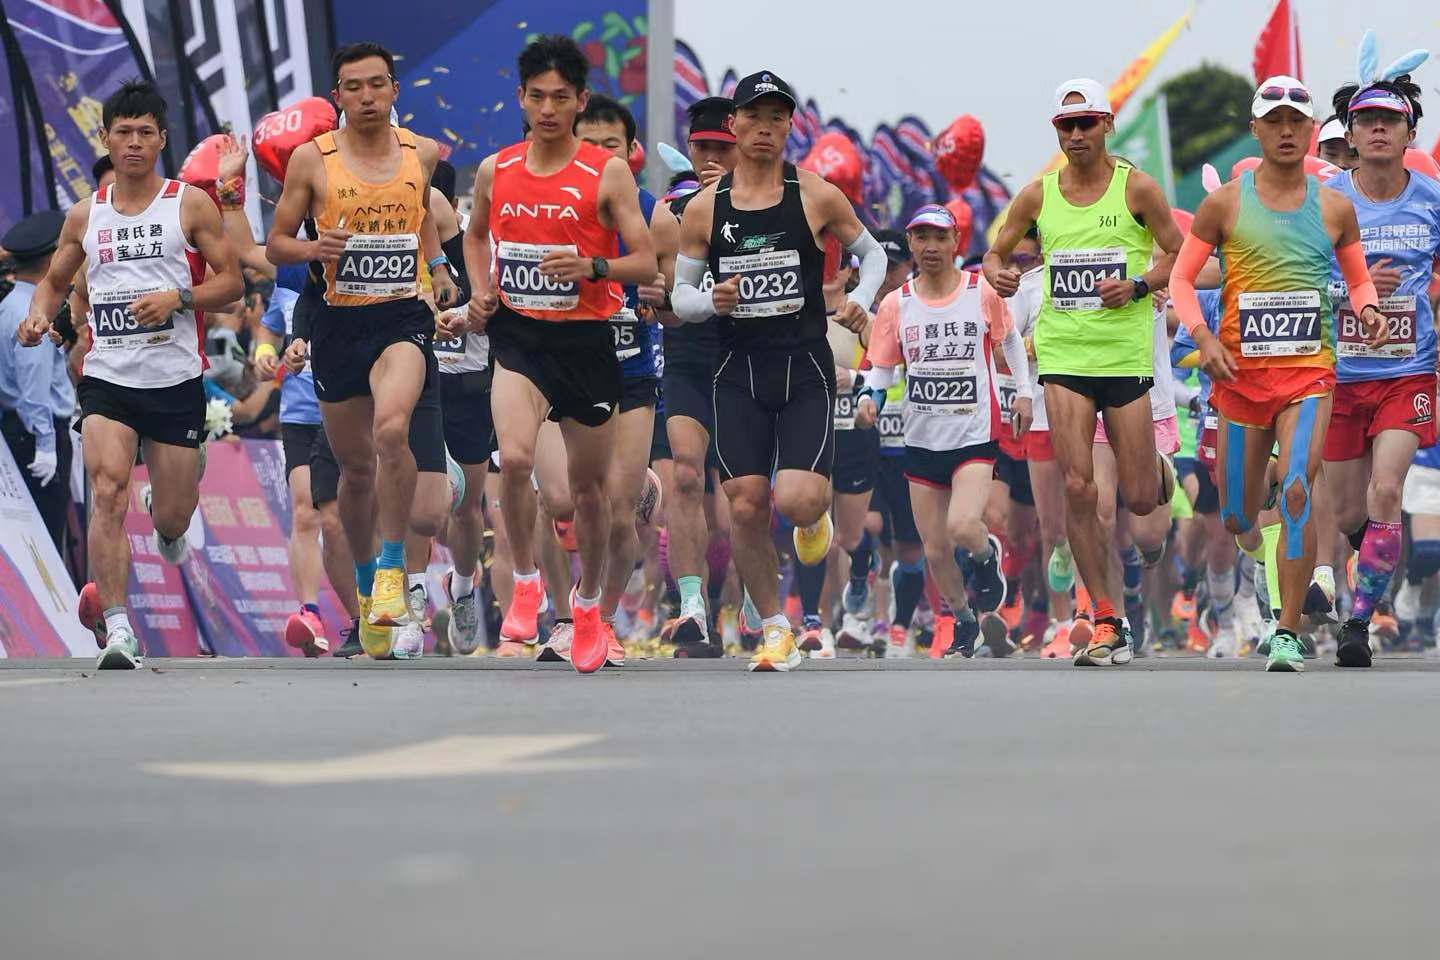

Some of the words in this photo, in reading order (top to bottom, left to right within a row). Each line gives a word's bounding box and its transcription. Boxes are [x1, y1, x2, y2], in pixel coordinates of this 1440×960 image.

[354, 203, 407, 216] ANTA
[500, 203, 579, 221] ANTA
[116, 241, 163, 259] 宝立方
[340, 254, 414, 279] A0292
[739, 271, 799, 300] 0232
[1243, 312, 1317, 338] A0277
[1342, 316, 1412, 339] B028
[924, 340, 976, 358] 宝立方
[911, 380, 974, 401] A0222
